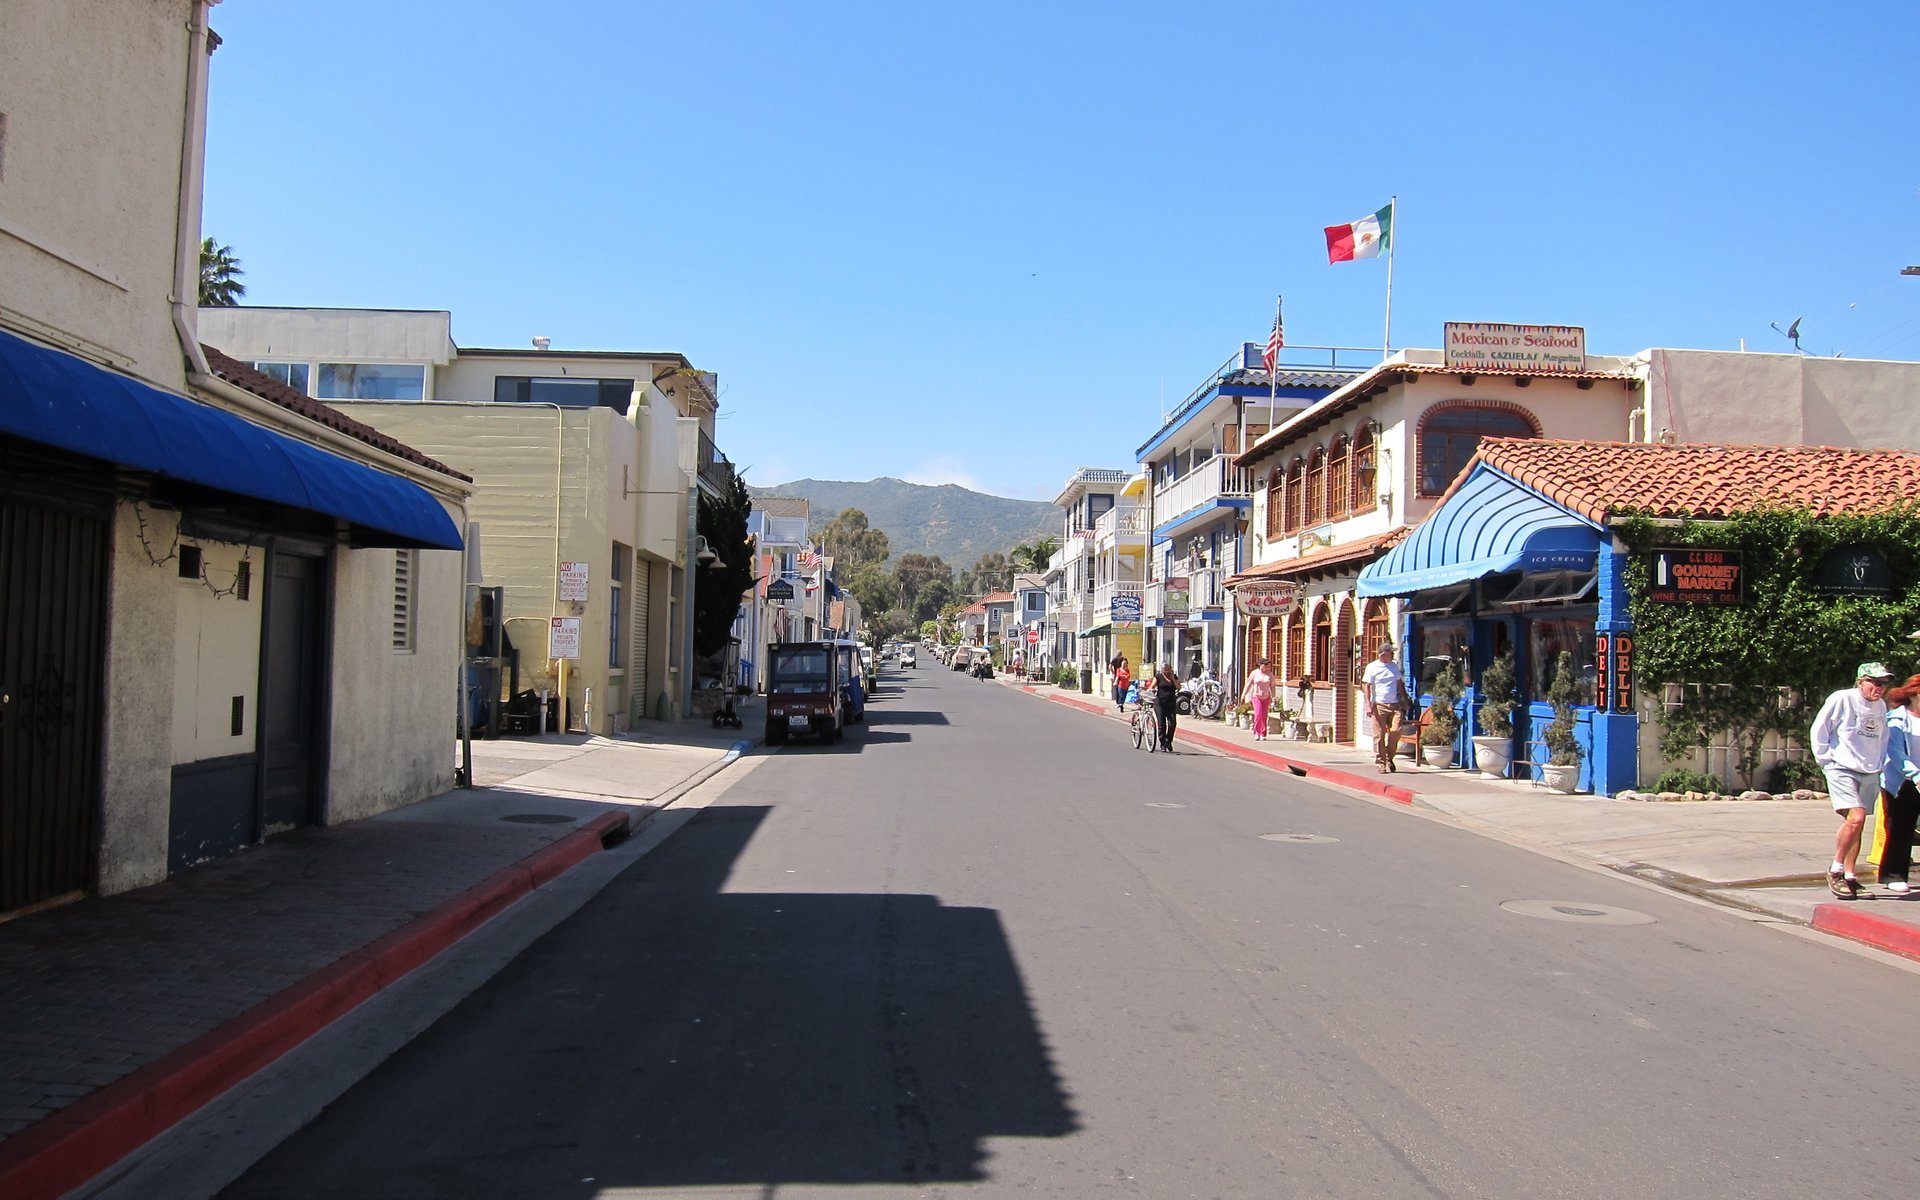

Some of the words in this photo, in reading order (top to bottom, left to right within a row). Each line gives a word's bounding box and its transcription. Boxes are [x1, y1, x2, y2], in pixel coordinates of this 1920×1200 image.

[1452, 332, 1508, 346] Mexican
[1524, 335, 1578, 348] Seafood
[1450, 350, 1485, 359] Cocktails
[1490, 351, 1538, 360] CAZUELAS
[1543, 352, 1581, 364] Margaritas
[1705, 553, 1724, 563] BEAU
[561, 563, 571, 571] NO
[1672, 564, 1740, 579] GOURMET
[1677, 577, 1735, 591] MARKET
[1652, 592, 1676, 601] WINE
[1679, 593, 1714, 601] CHEESE
[1720, 594, 1740, 602] DELI
[1248, 606, 1273, 614] Mexican
[1274, 604, 1290, 614] Food
[1598, 637, 1607, 706] DELI
[1616, 637, 1632, 708] DELI
